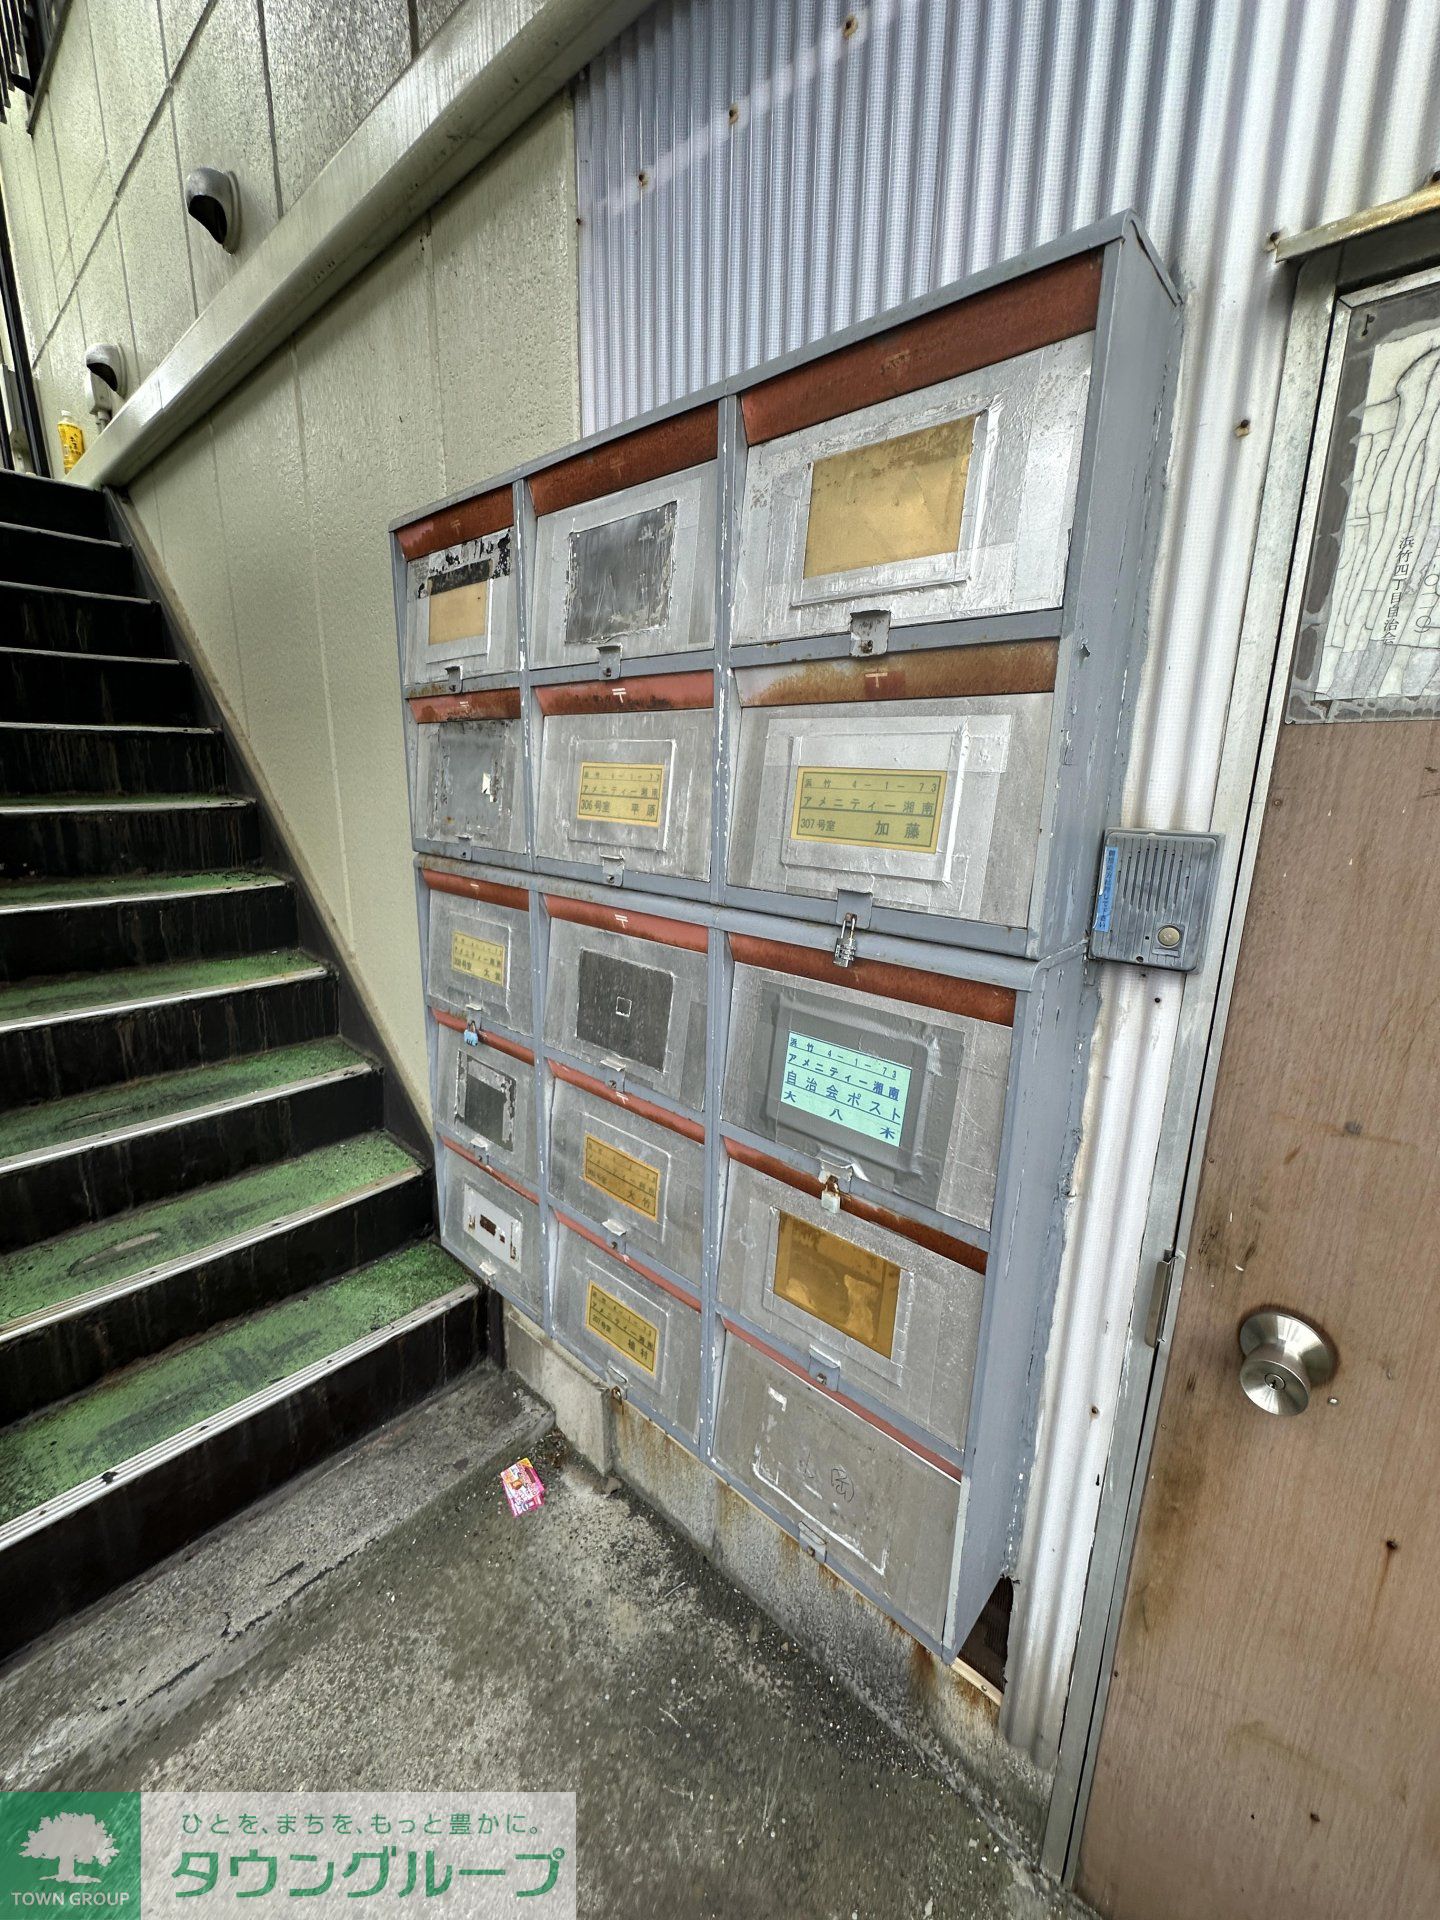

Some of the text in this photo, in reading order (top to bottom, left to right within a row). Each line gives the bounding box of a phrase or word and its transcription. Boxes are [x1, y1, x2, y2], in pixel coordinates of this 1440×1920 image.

[1382, 536, 1415, 645] 浜竹四丁目自治会
[800, 819, 921, 840] 307号室 加藤
[803, 796, 935, 815] アメニティー湘南
[786, 1071, 901, 1121] 自治会ポスト
[788, 1053, 900, 1101] アメニティー湘南
